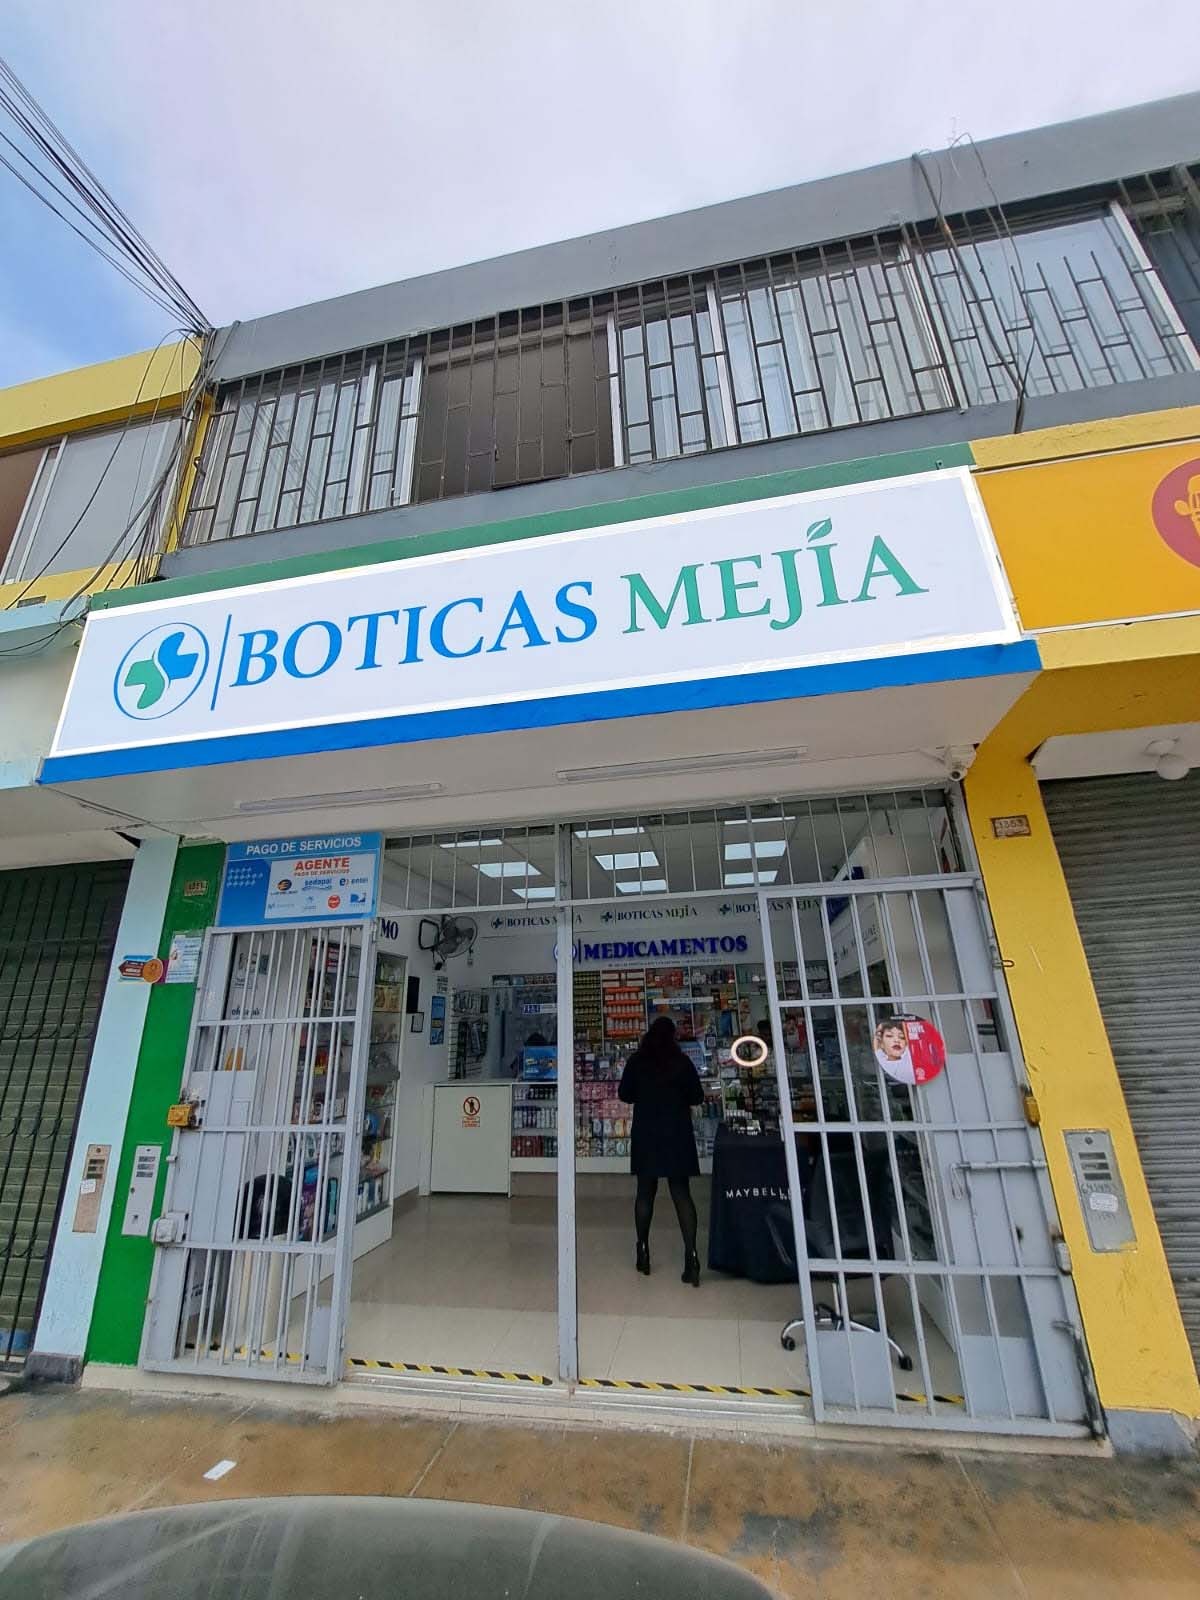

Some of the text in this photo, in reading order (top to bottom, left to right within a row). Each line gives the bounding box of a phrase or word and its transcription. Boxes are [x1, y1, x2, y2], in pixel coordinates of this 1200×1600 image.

[229, 516, 930, 688] BOTICAS MEJÍA
[245, 836, 362, 856] PAGO DE SERVICIOS
[294, 857, 351, 872] AGENTE
[507, 915, 551, 928] BOTICAS
[618, 904, 699, 921] BOTICAS MEJÍA
[584, 934, 748, 961] MEDICAMENTOS
